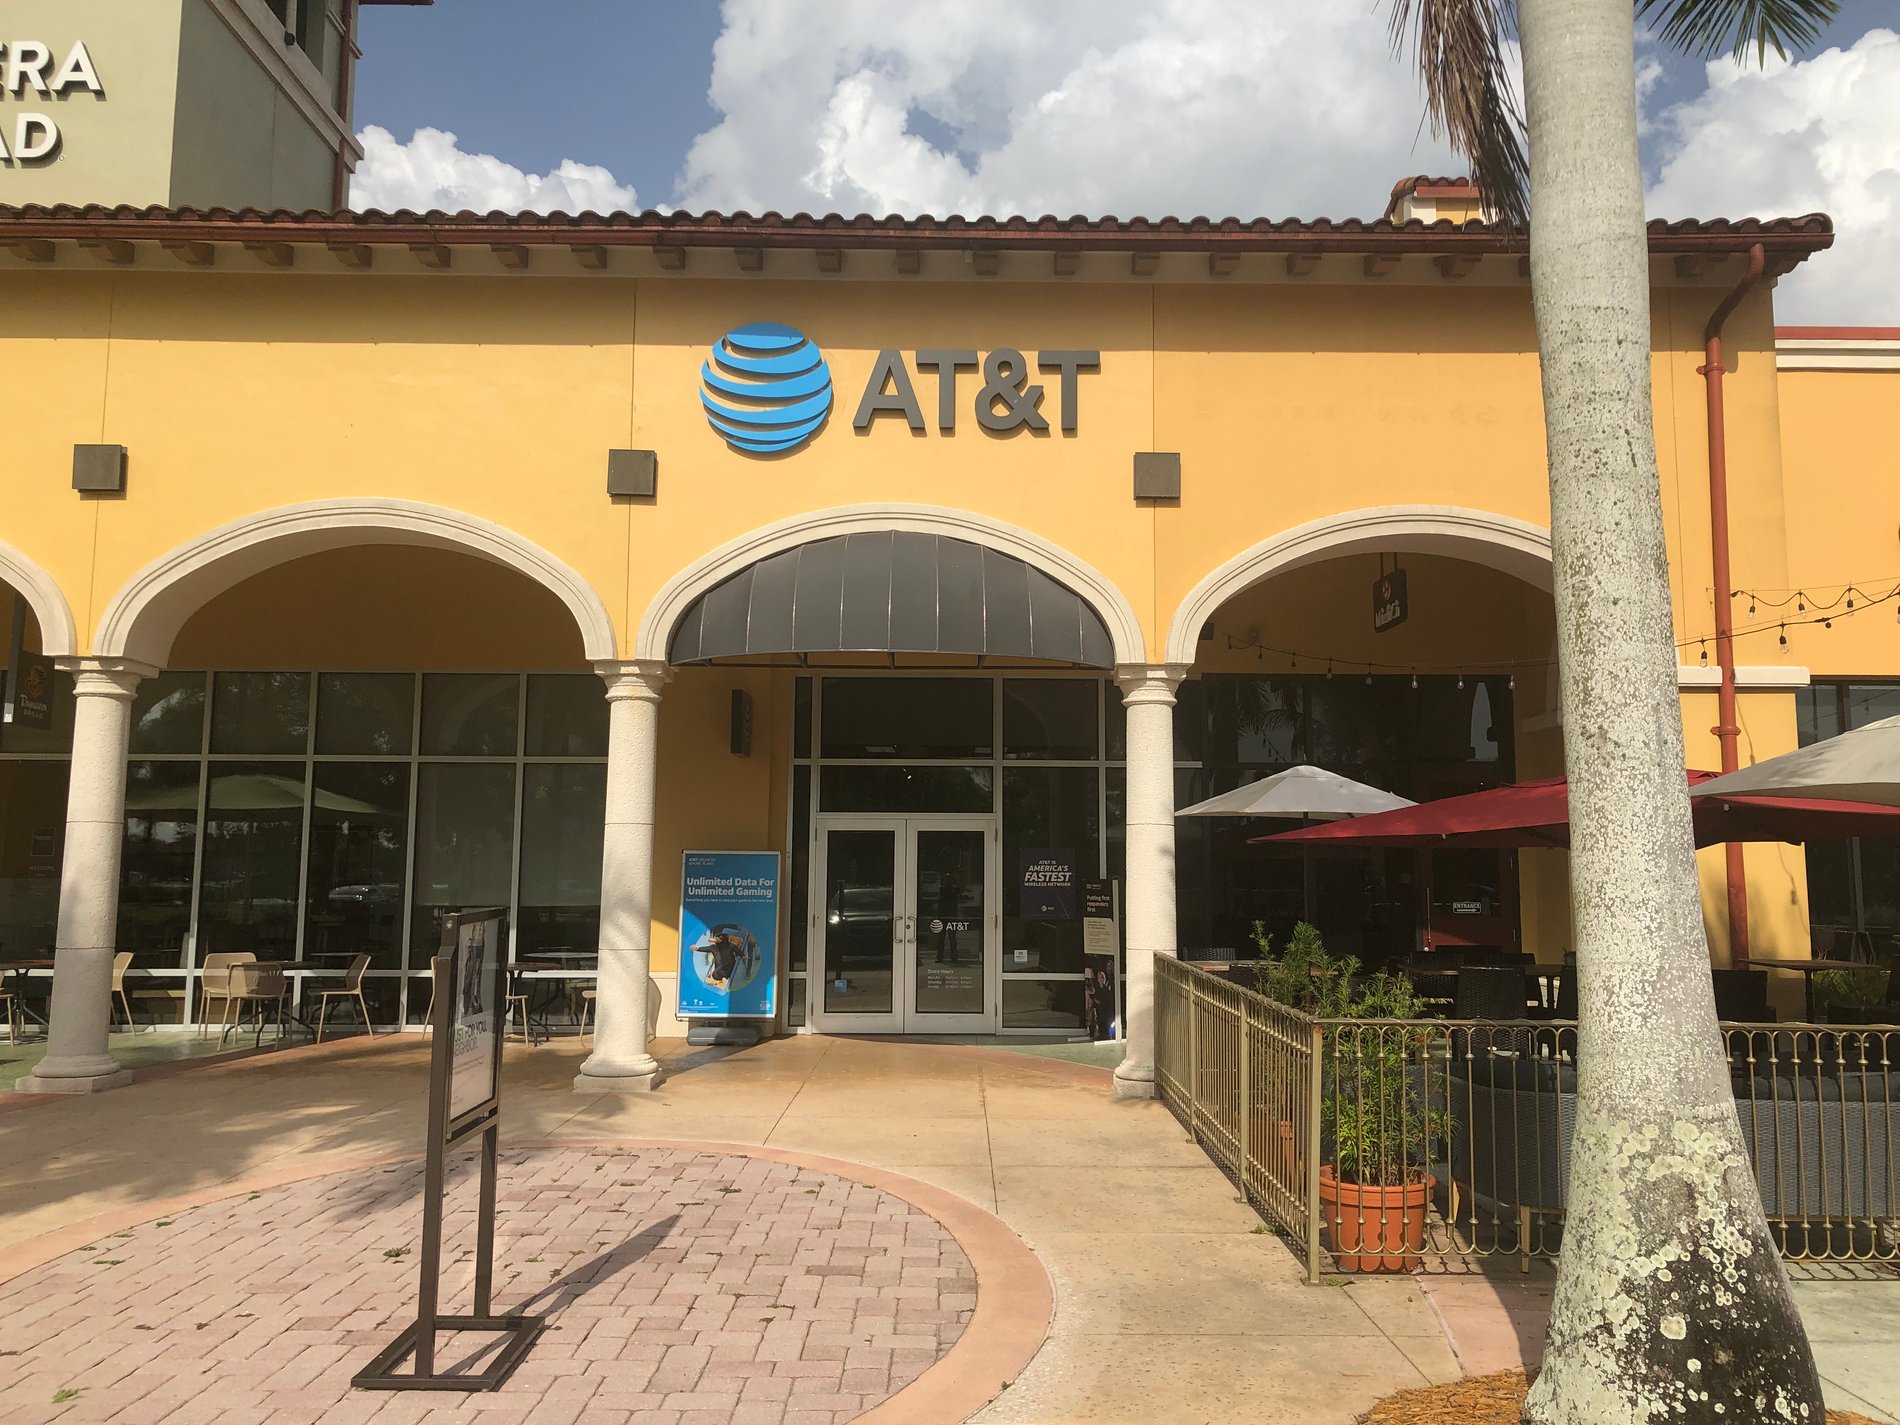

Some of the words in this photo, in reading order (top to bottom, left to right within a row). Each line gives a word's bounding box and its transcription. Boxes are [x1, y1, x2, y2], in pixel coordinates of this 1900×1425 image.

[852, 348, 1100, 437] AT&T
[686, 877, 733, 886] Unlimited
[734, 877, 757, 886] Data
[759, 878, 775, 886] For
[1024, 872, 1072, 882] FASTEST
[688, 887, 734, 896] Unlimited
[736, 887, 772, 898] Gaming
[945, 922, 969, 931] AT&T
